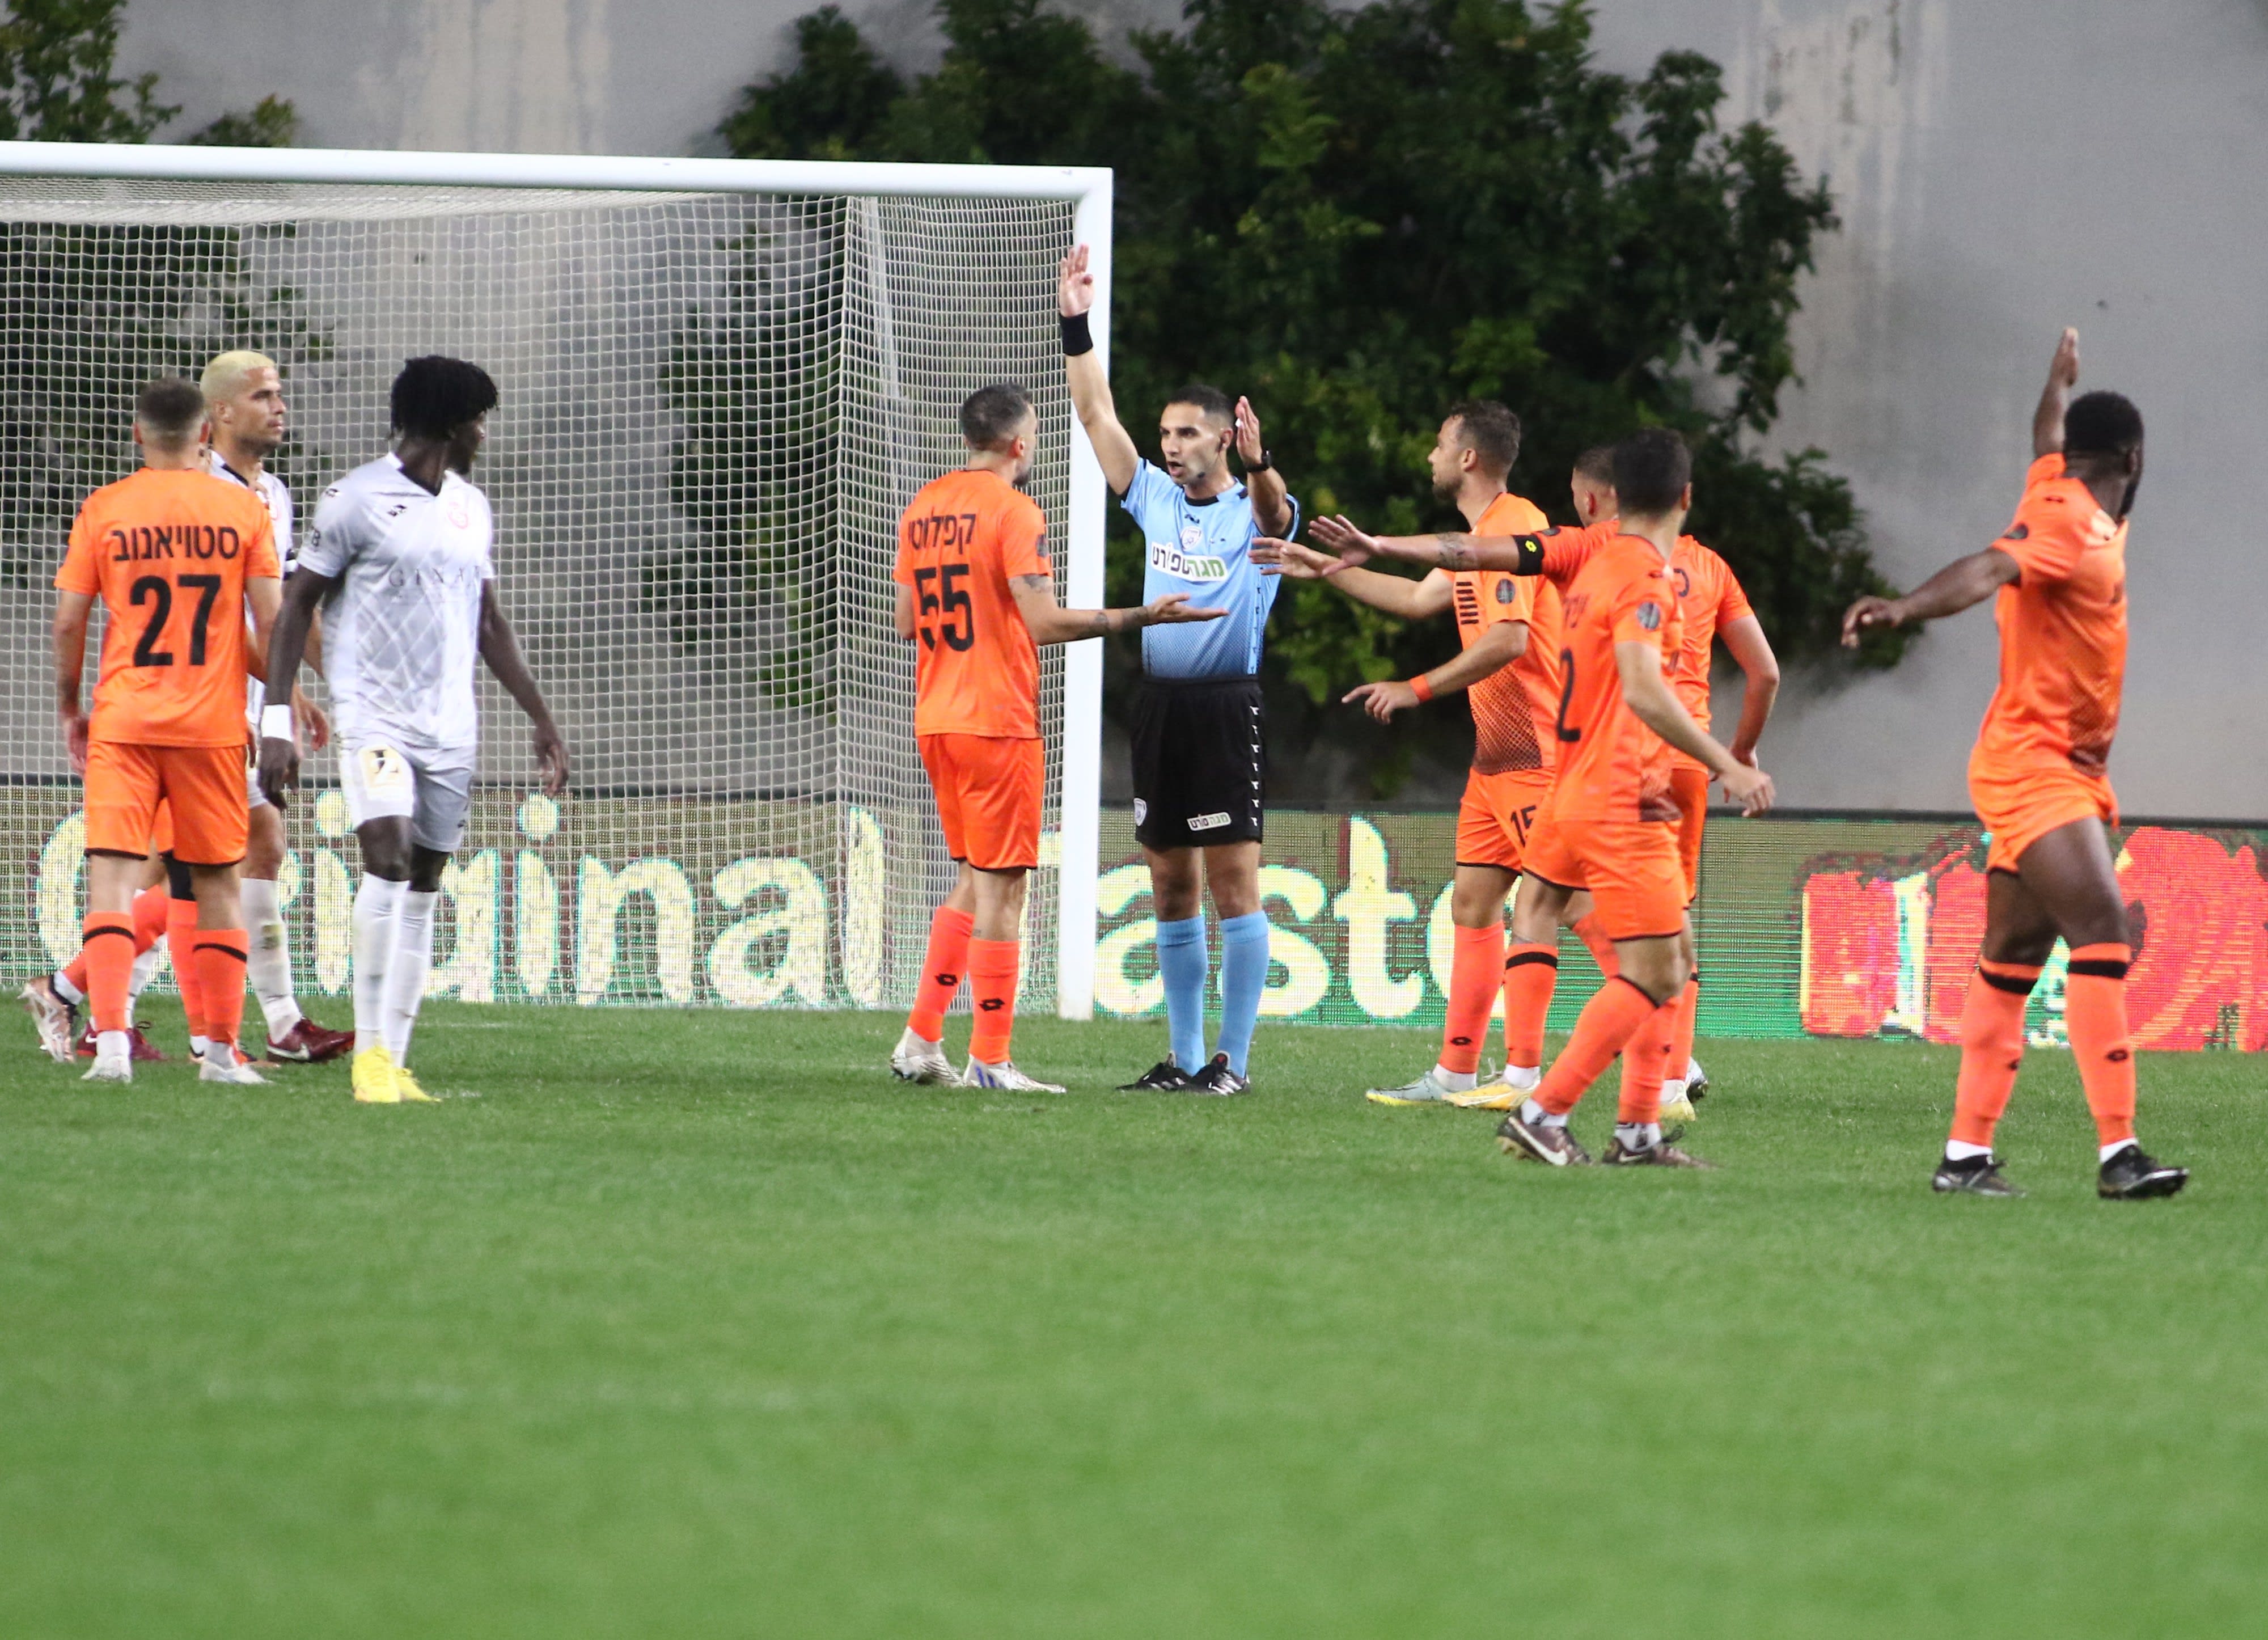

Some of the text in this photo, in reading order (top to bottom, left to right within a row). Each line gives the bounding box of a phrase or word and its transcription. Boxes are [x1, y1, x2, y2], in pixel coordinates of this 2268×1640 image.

[111, 525, 239, 561] סטויאנוב
[130, 574, 221, 667] 27
[914, 564, 974, 652] 55
[1556, 648, 1581, 742] 2
[1021, 815, 1525, 1019] ast
